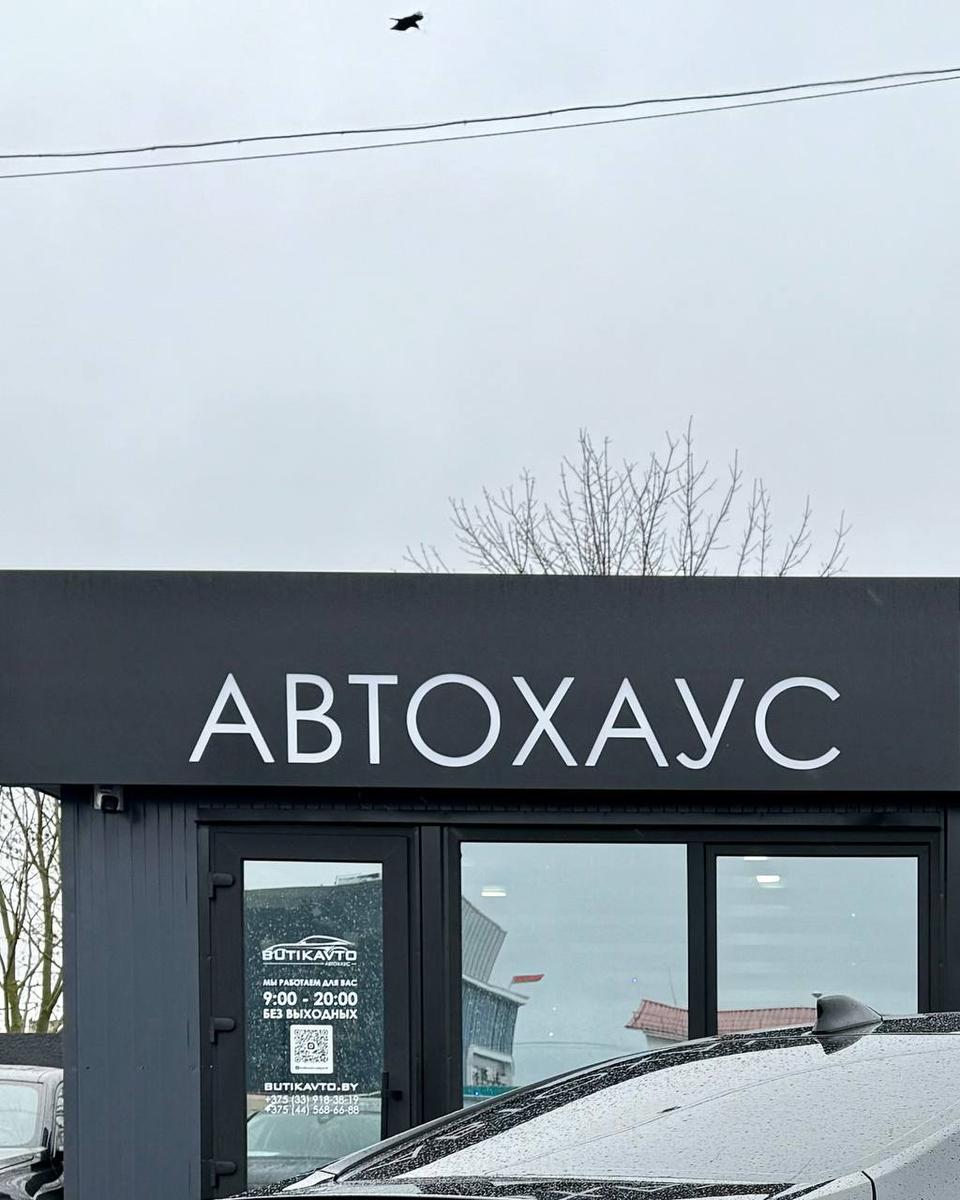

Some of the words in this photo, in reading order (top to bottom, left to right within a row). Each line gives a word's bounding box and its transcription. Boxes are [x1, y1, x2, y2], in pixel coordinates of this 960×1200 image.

[188, 672, 842, 770] АВТОХАУС
[262, 949, 358, 961] BUTIKAVTO
[262, 978, 278, 987] МЫ
[279, 978, 321, 987] РАБОТАЕМ
[322, 979, 339, 988] ДЛЯ
[340, 978, 358, 987] ВАС
[263, 991, 297, 1006] 9:00
[313, 991, 358, 1006] 20:00
[263, 1008, 283, 1019] БЕЗ
[286, 1008, 358, 1020] ВЫХОДНЫХ
[264, 1082, 359, 1091] BUTIKAVTO.BY
[265, 1095, 289, 1104] +375
[291, 1094, 310, 1106] (33)
[312, 1095, 359, 1104] 918-38-19
[265, 1105, 289, 1114] +375
[291, 1104, 310, 1116] (44)
[312, 1105, 360, 1114] 568-66-88
